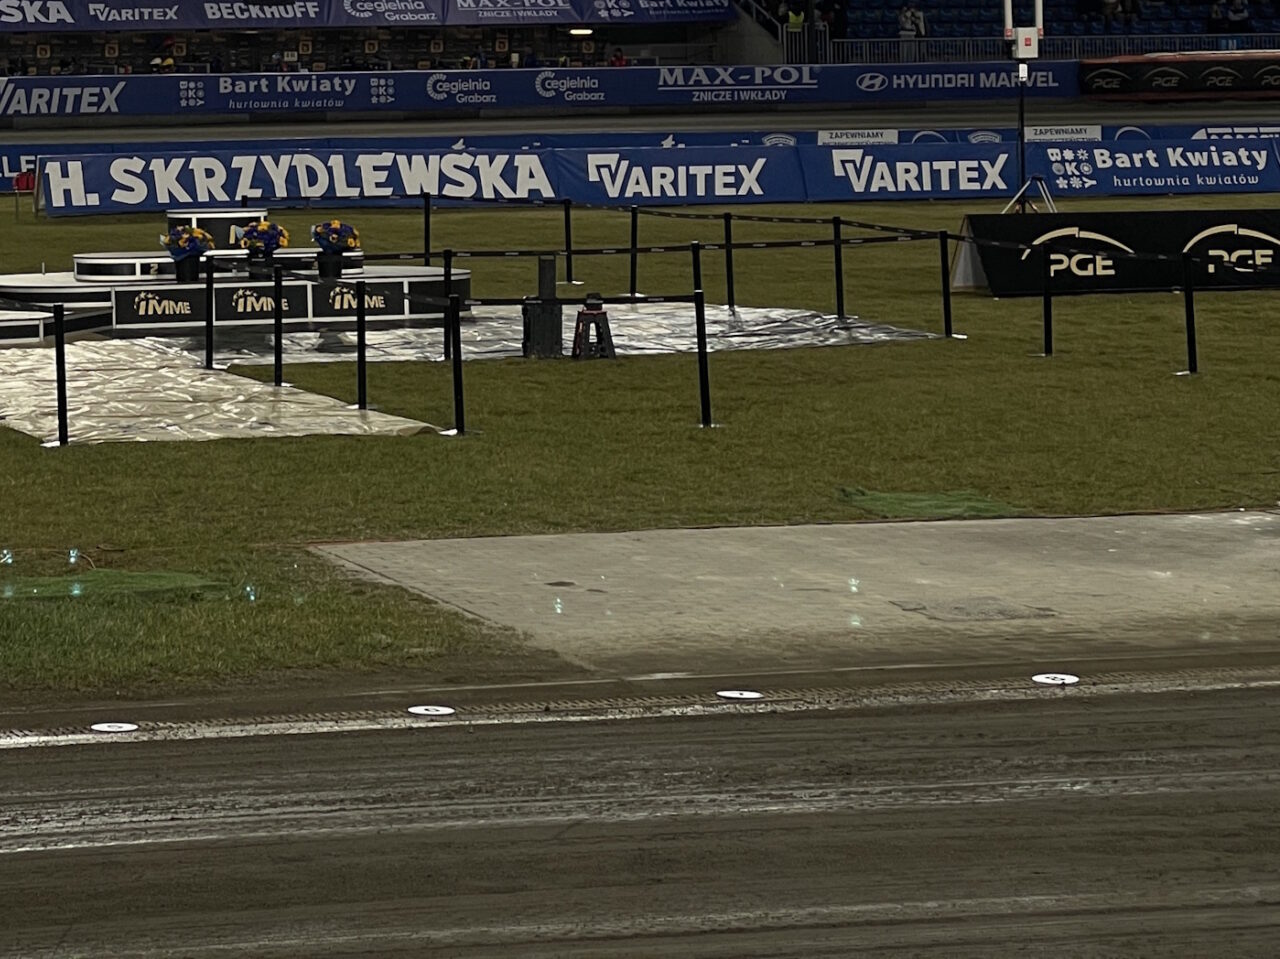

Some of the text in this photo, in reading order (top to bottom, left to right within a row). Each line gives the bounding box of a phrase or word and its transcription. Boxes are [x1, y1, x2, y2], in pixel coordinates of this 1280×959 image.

[88, 3, 179, 22] VARITEX
[640, 0, 672, 9] Bart
[385, 12, 437, 21] Grabarz
[219, 77, 269, 94] Bart
[277, 75, 357, 96] Kwiaty
[658, 67, 818, 86] MAX-POL
[892, 73, 975, 89] HYUNDAI
[455, 93, 497, 103] Grabarz
[564, 91, 605, 102] Grabarz
[692, 90, 731, 102] ZNICZE
[740, 89, 788, 101] WKŁADY
[1093, 147, 1160, 169] Bart
[1166, 145, 1267, 171] Kwiaty
[587, 153, 767, 198] VARITEX
[832, 148, 1009, 192] VARITEX
[45, 152, 556, 208] H. SKRZYDLEWSKA
[1113, 174, 1259, 187] hurtownia kwiatów
[1049, 252, 1116, 278] PGE
